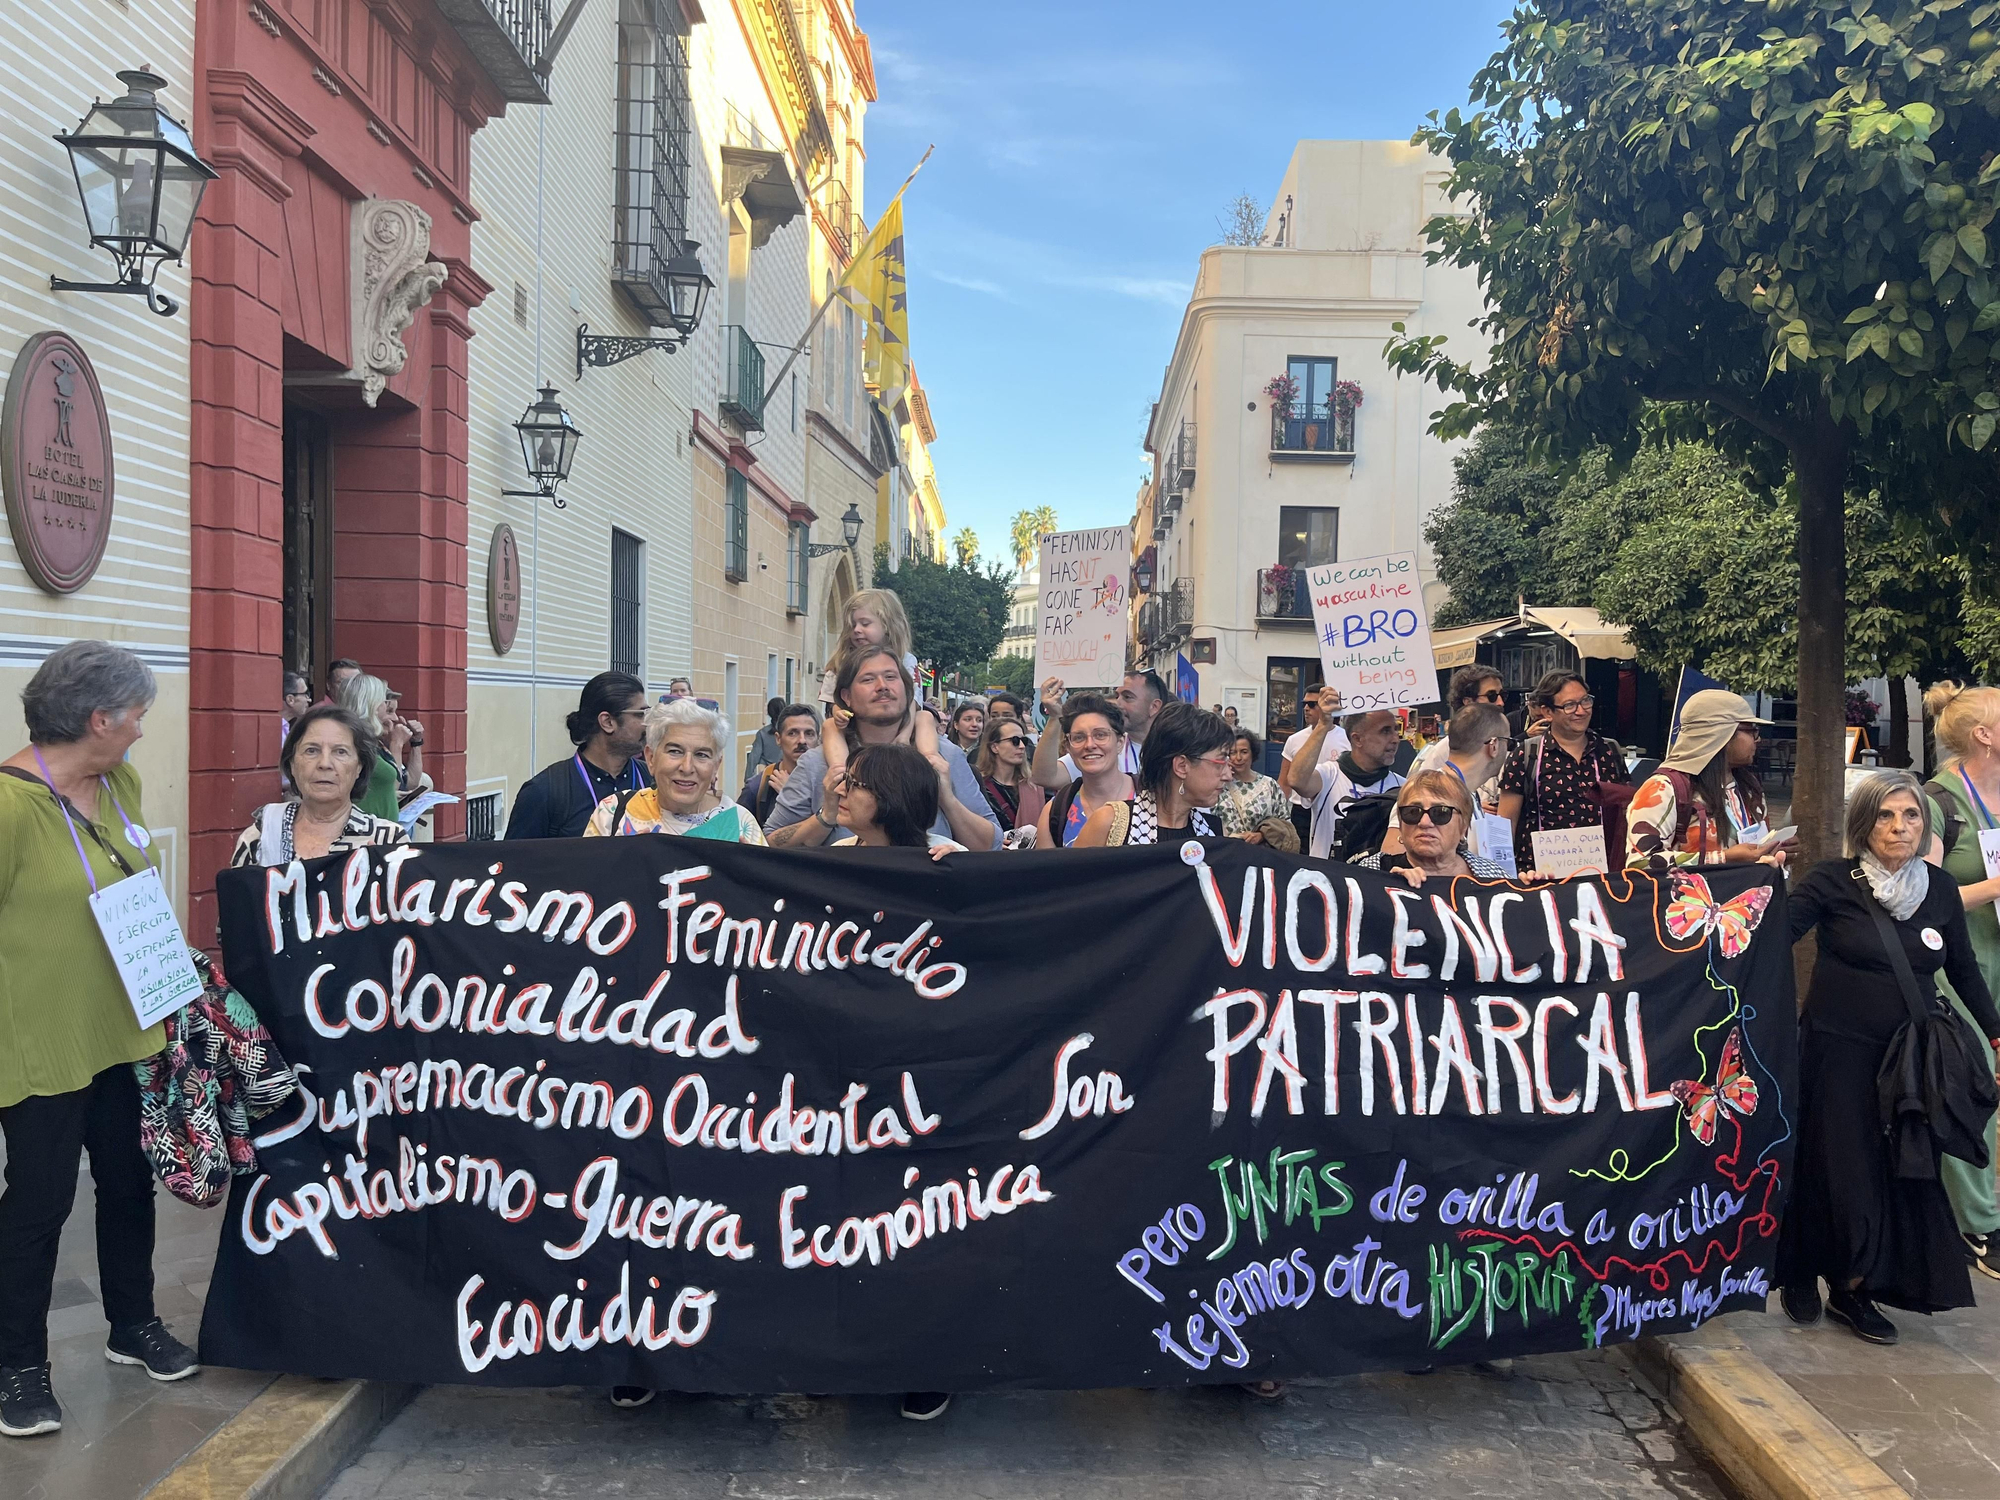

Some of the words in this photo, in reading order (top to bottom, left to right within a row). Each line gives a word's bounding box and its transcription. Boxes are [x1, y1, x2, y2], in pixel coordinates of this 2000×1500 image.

[28, 462, 50, 480] LAS
[51, 468, 87, 489] CASAS
[89, 476, 104, 492] DE
[44, 446, 85, 469] HOTEL
[32, 485, 48, 501] LA
[1313, 569, 1346, 587] We
[1349, 565, 1382, 580] can
[1386, 558, 1410, 573] be
[1316, 582, 1412, 608] masculine
[1321, 608, 1418, 649] #BRO
[1332, 645, 1406, 669] without
[1359, 668, 1417, 686] being
[1590, 846, 1601, 854] LA
[265, 844, 638, 956] Militarismo
[658, 864, 968, 1000] Feminicidio
[1197, 864, 1627, 984] VIOLENCIA
[124, 928, 179, 965] DEFIENDE
[137, 966, 149, 982] LA
[141, 1002, 148, 1011] A
[150, 994, 163, 1007] LAS
[304, 935, 762, 1058] Colonialidad
[1194, 987, 1674, 1118] PATRIARCAL
[1018, 1032, 1135, 1141] Son
[253, 1058, 653, 1157] Supremacismo
[662, 1071, 942, 1155] Occidental
[779, 1164, 1055, 1269] Económica
[1206, 1146, 1354, 1261] JUNTAS
[1369, 1158, 1427, 1223] de
[1439, 1172, 1576, 1237] orilla
[1585, 1208, 1616, 1245] a
[1629, 1183, 1748, 1250] orilla
[457, 1260, 718, 1373] Ecocidio
[1152, 1247, 1317, 1371] tejemos
[1324, 1235, 1423, 1319] otra
